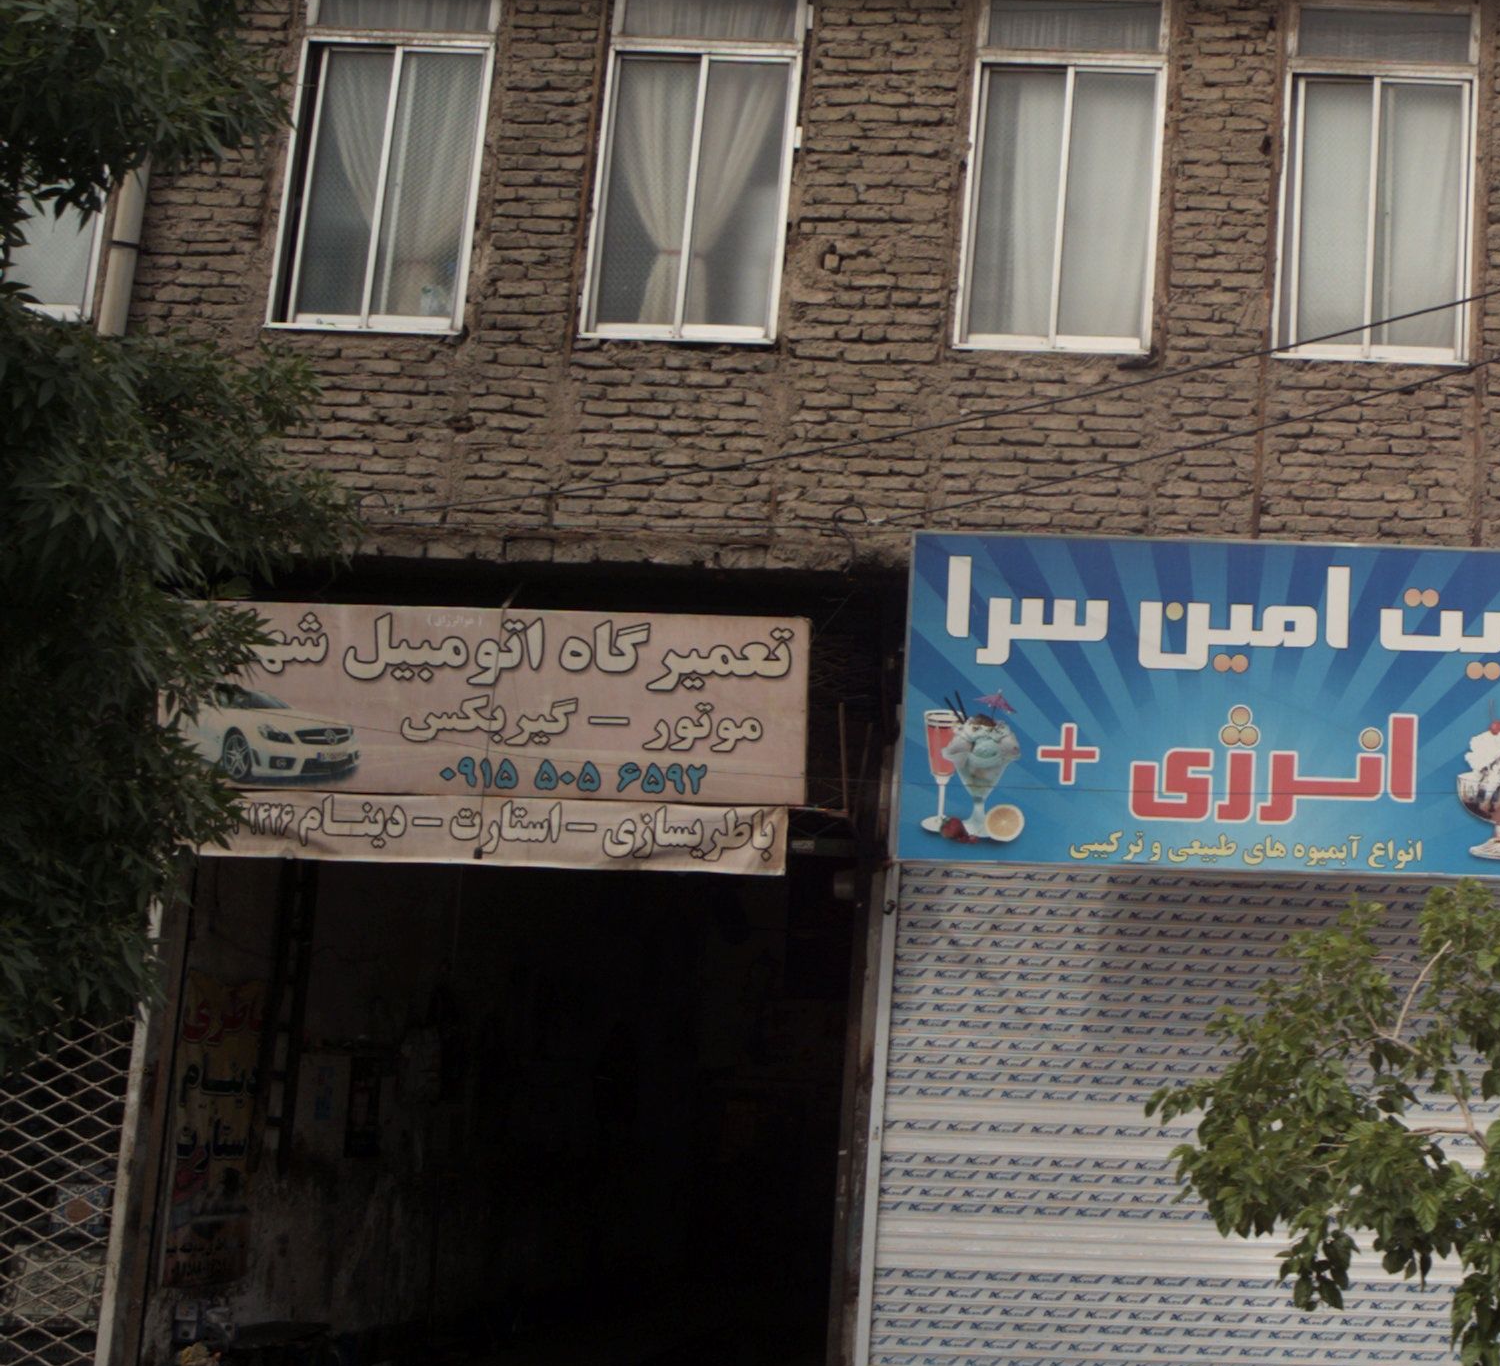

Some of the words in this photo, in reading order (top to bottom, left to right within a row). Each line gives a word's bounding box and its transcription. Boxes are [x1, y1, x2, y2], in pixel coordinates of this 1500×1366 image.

[946, 555, 1109, 665] سرا
[1138, 566, 1350, 674] امین
[343, 612, 545, 686] اتومبیل
[401, 695, 578, 747] گیربکس
[642, 702, 763, 752] موتور
[440, 756, 518, 789] ۰۹۱۵
[534, 759, 601, 792] ۵۰۵
[617, 762, 707, 795] ۶۵۹۲
[1129, 705, 1418, 824] انرژی
[299, 794, 407, 849] دینام
[450, 800, 562, 854] استارت
[1150, 840, 1162, 862] و
[1168, 834, 1237, 863] طبیعی
[1243, 835, 1287, 865] های
[1294, 835, 1361, 867] آبمیوه
[1367, 839, 1423, 869] انواع
